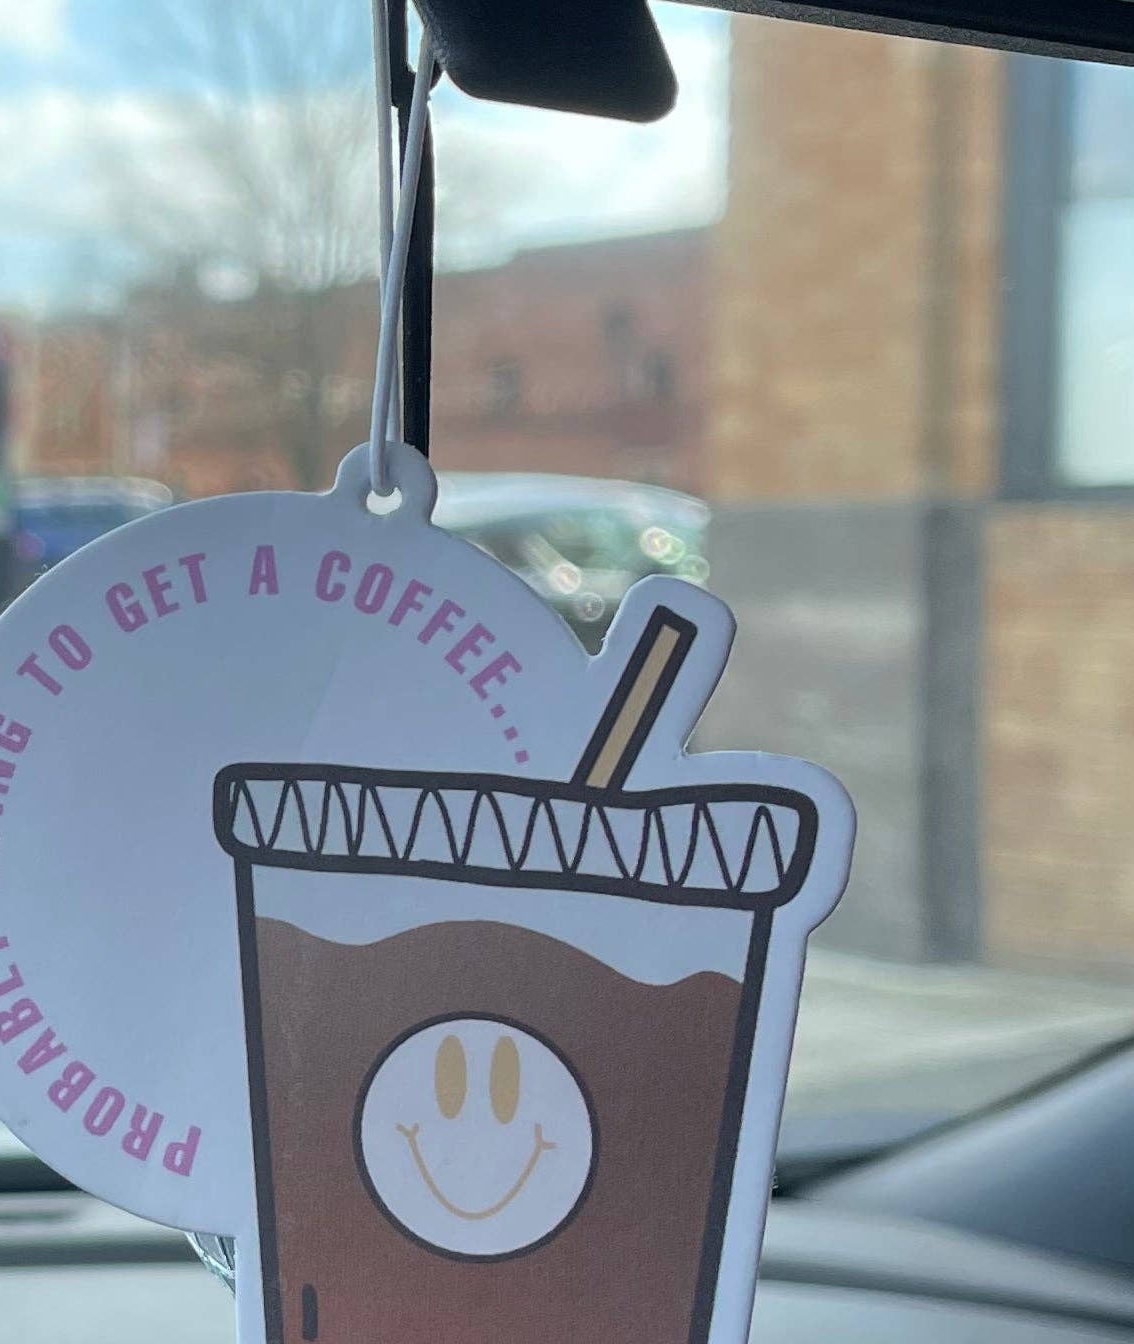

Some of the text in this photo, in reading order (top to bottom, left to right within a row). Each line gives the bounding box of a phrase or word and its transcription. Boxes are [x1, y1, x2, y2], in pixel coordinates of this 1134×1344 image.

[16, 623, 93, 697] TO
[104, 553, 209, 633] GET
[249, 545, 279, 596] A
[315, 550, 530, 763] COFFEE...
